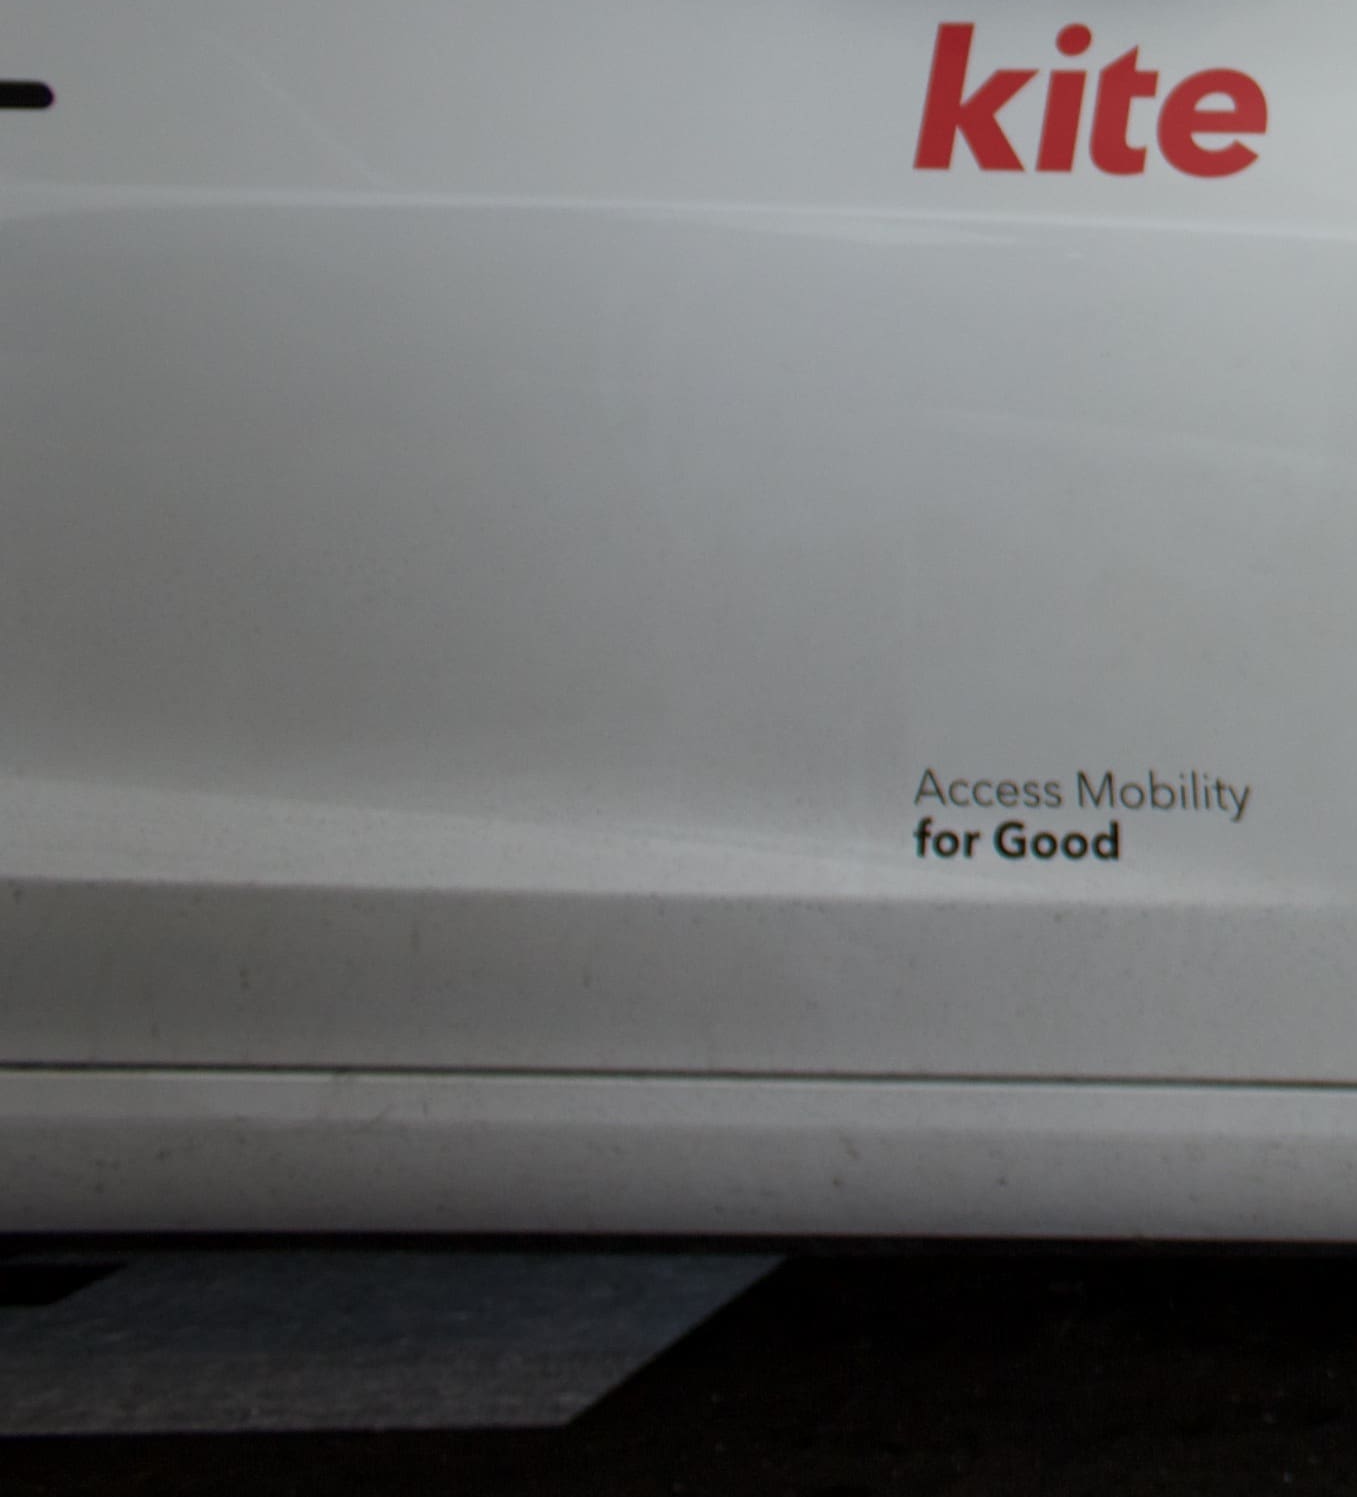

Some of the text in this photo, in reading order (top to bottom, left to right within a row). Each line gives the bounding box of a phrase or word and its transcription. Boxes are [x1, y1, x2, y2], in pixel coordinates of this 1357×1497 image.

[913, 21, 1268, 178] kite
[914, 767, 1251, 822] Access Mobility
[914, 816, 1121, 861] for Good
